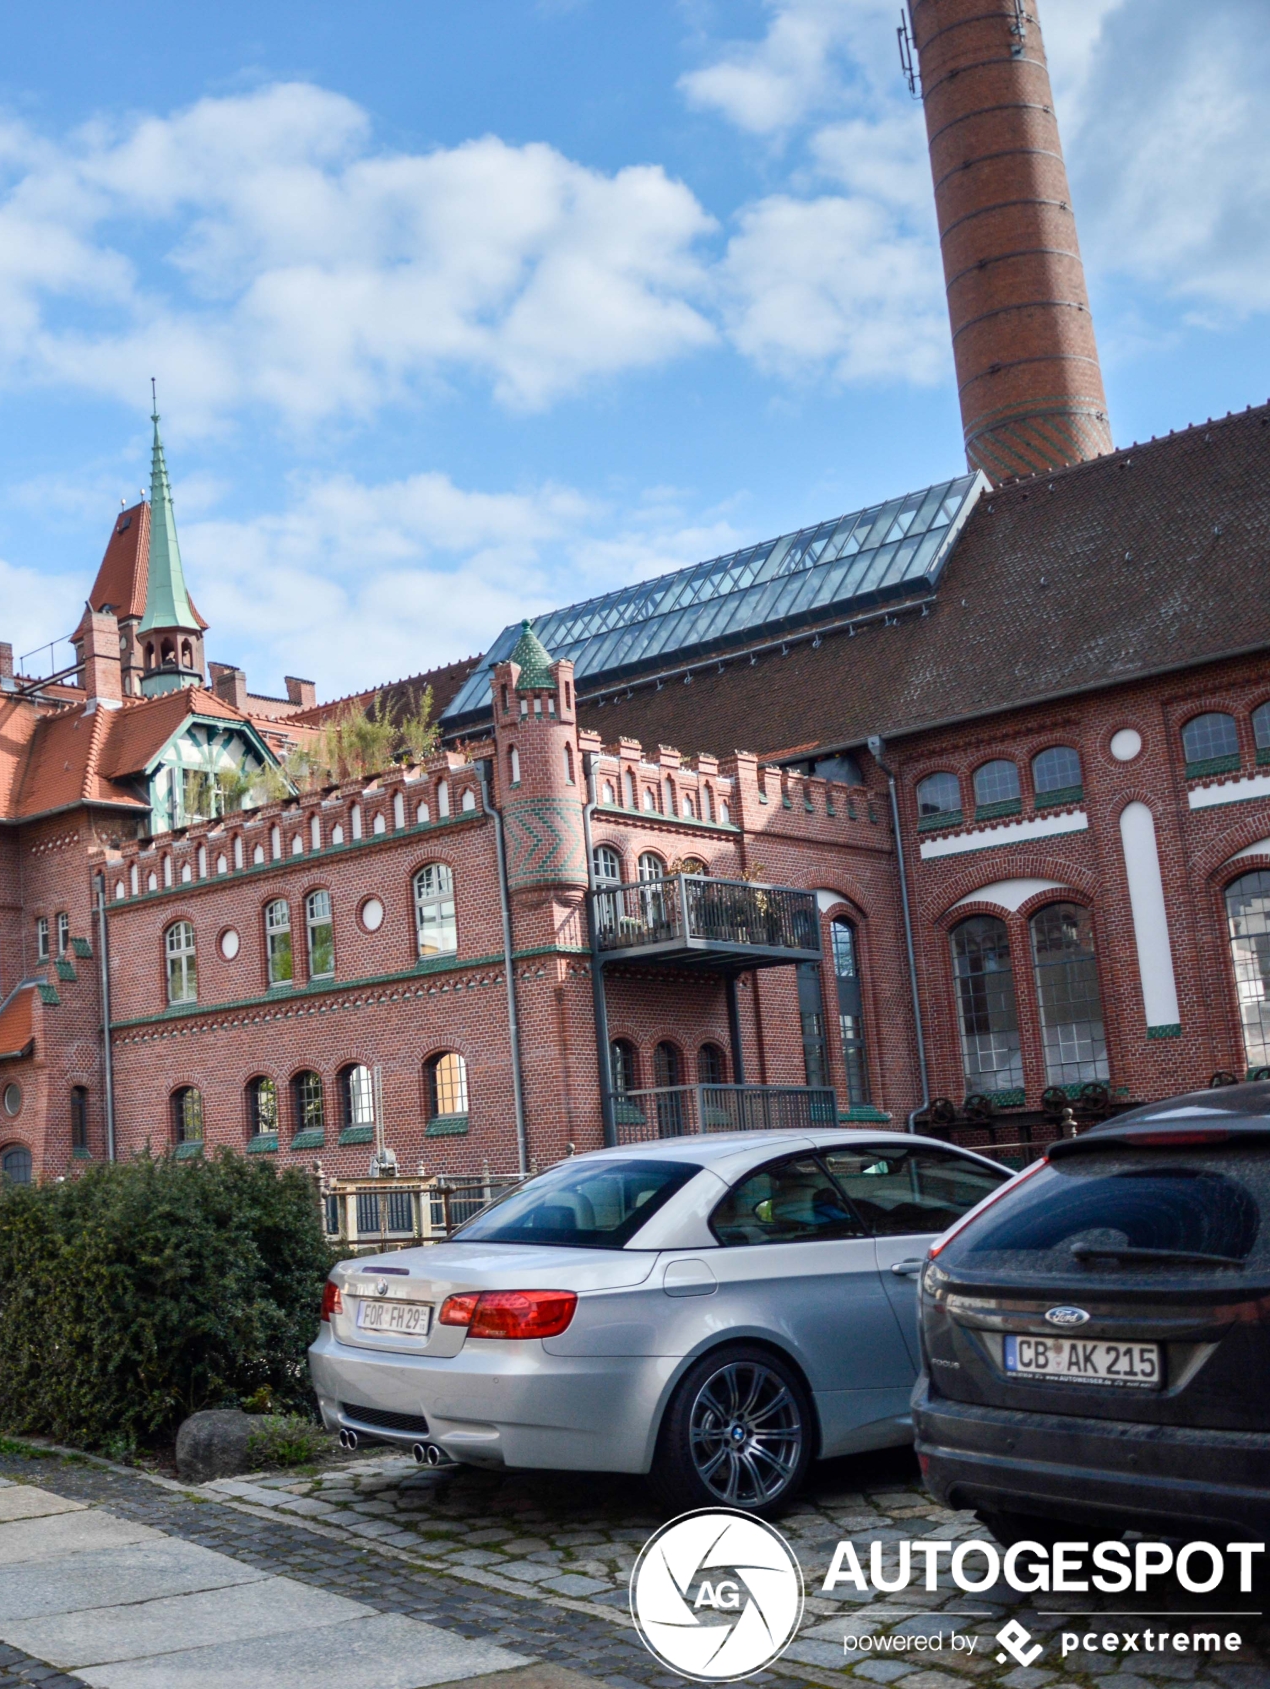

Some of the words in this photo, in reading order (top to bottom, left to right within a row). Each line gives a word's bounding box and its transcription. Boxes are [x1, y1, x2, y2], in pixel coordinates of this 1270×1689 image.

[363, 1304, 384, 1326] FOR
[389, 1306, 405, 1328] FH
[405, 1308, 420, 1330] 29
[1052, 1308, 1078, 1323] Ford
[932, 1358, 961, 1369] FOCUS
[1019, 1339, 1049, 1369] CB
[1067, 1343, 1099, 1373] AK
[1105, 1346, 1156, 1378] 215
